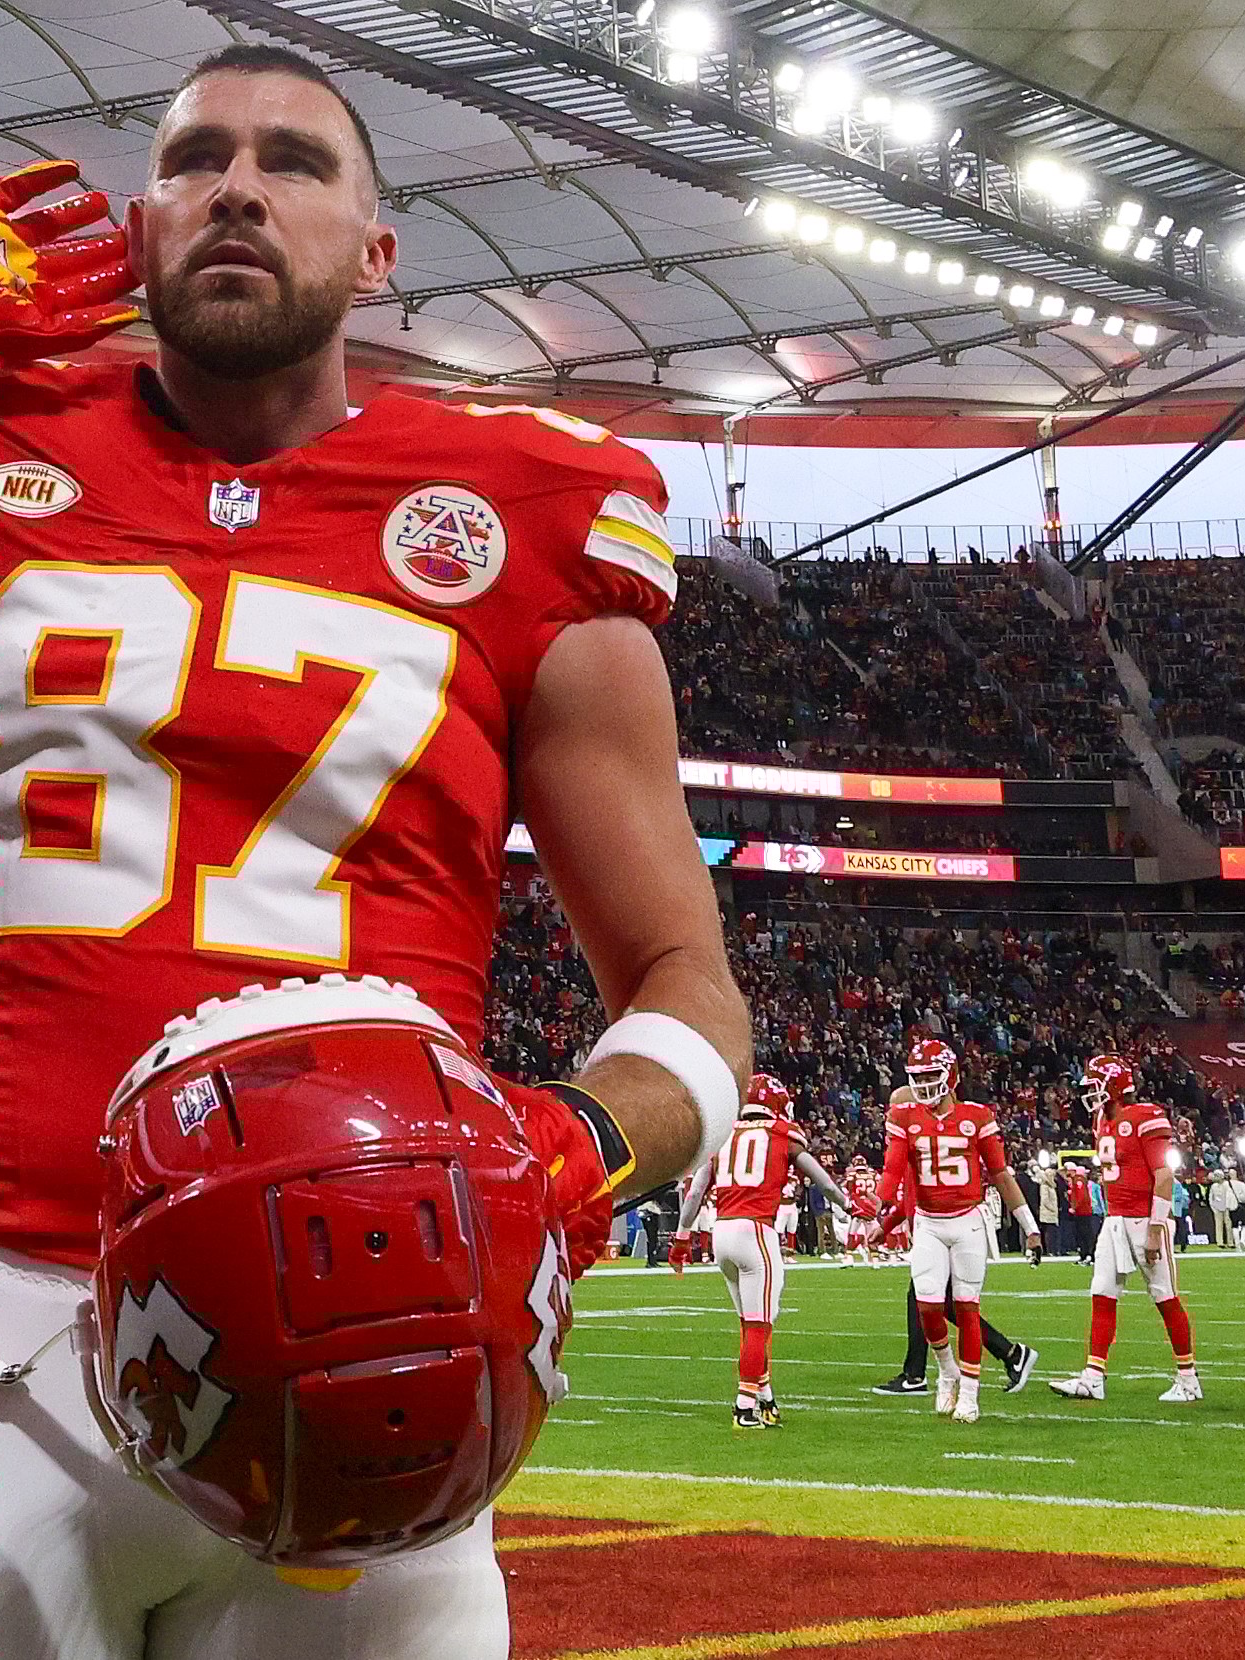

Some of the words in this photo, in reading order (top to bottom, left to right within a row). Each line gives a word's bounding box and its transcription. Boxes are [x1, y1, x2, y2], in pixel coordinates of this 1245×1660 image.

[1, 475, 56, 504] NKH
[217, 501, 248, 522] NFL
[847, 853, 898, 872] KANSAS
[900, 857, 933, 873] CITY
[935, 858, 989, 877] CHIEFS
[715, 1127, 770, 1188] 10
[914, 1135, 971, 1187] 15
[1098, 1135, 1121, 1182] 9
